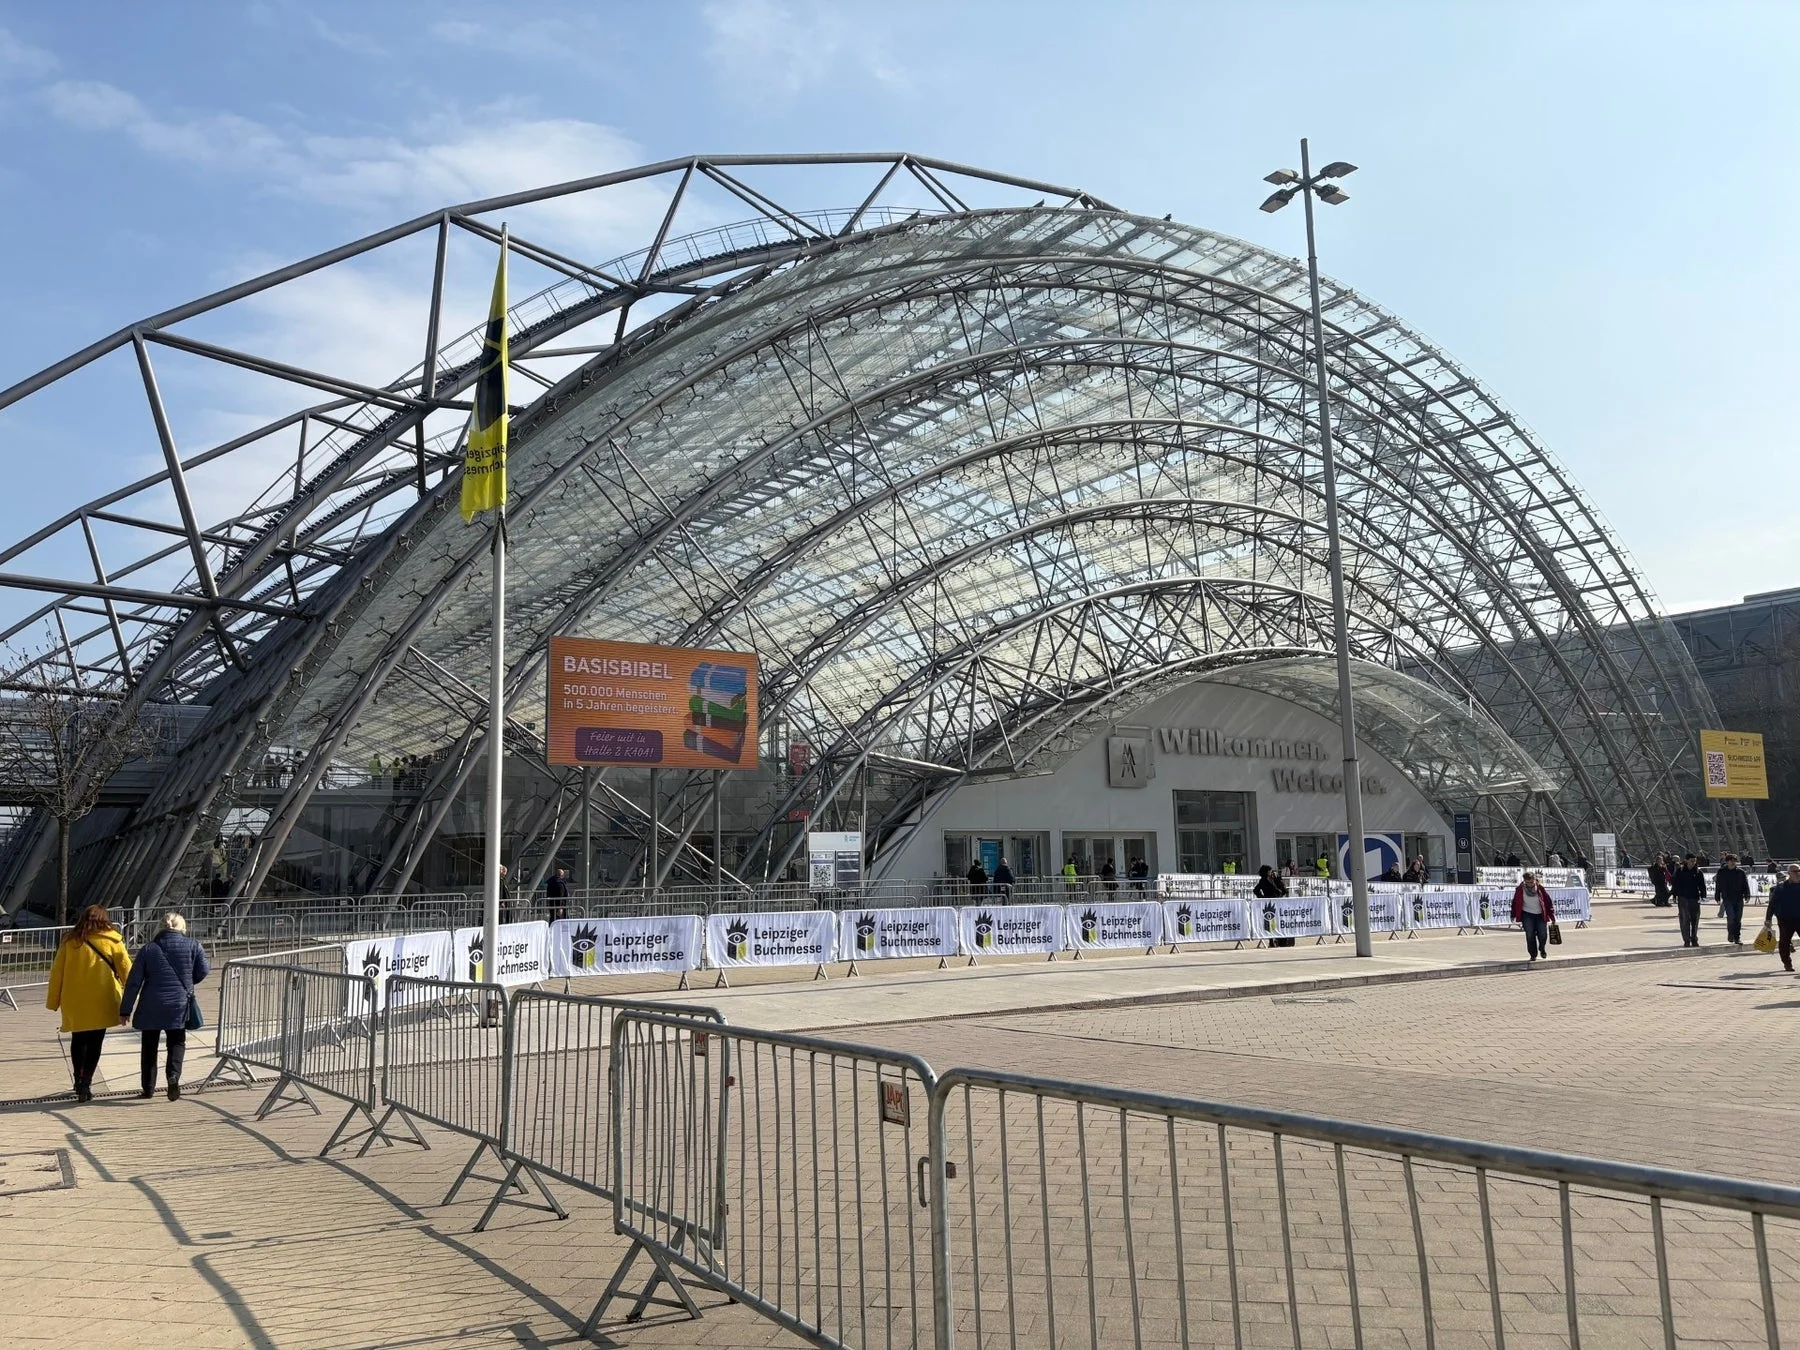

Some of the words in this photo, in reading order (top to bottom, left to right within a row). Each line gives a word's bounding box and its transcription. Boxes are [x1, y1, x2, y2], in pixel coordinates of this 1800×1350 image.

[563, 655, 673, 679] BASISBIBEL
[563, 684, 613, 697] 500.000
[615, 687, 667, 700] Menschen
[576, 699, 584, 709] 5
[586, 700, 623, 711] Jahren
[625, 702, 679, 714] begeistert.
[590, 731, 615, 742] Feier
[1160, 728, 1328, 761] Willkommen.
[1272, 768, 1387, 794] Welcoe.
[1196, 909, 1232, 920] Leipziger
[1279, 907, 1313, 918] Leipziger
[881, 920, 929, 935] Leipziger
[997, 919, 1041, 932] Leipziger
[1101, 915, 1142, 928] Leipziger
[1196, 920, 1241, 932] Buchmesse
[1280, 918, 1322, 929] Buchmesse
[604, 932, 669, 949] Leipziger
[754, 926, 808, 943] Leipziger
[881, 933, 941, 948] Buchmesse
[997, 931, 1053, 945] Buchmesse
[1101, 927, 1152, 940] Buchmesse
[497, 941, 529, 959] ipziger
[604, 949, 684, 963] Buchmesse
[754, 942, 822, 956] Buchmesse
[386, 953, 430, 975] Leipziger
